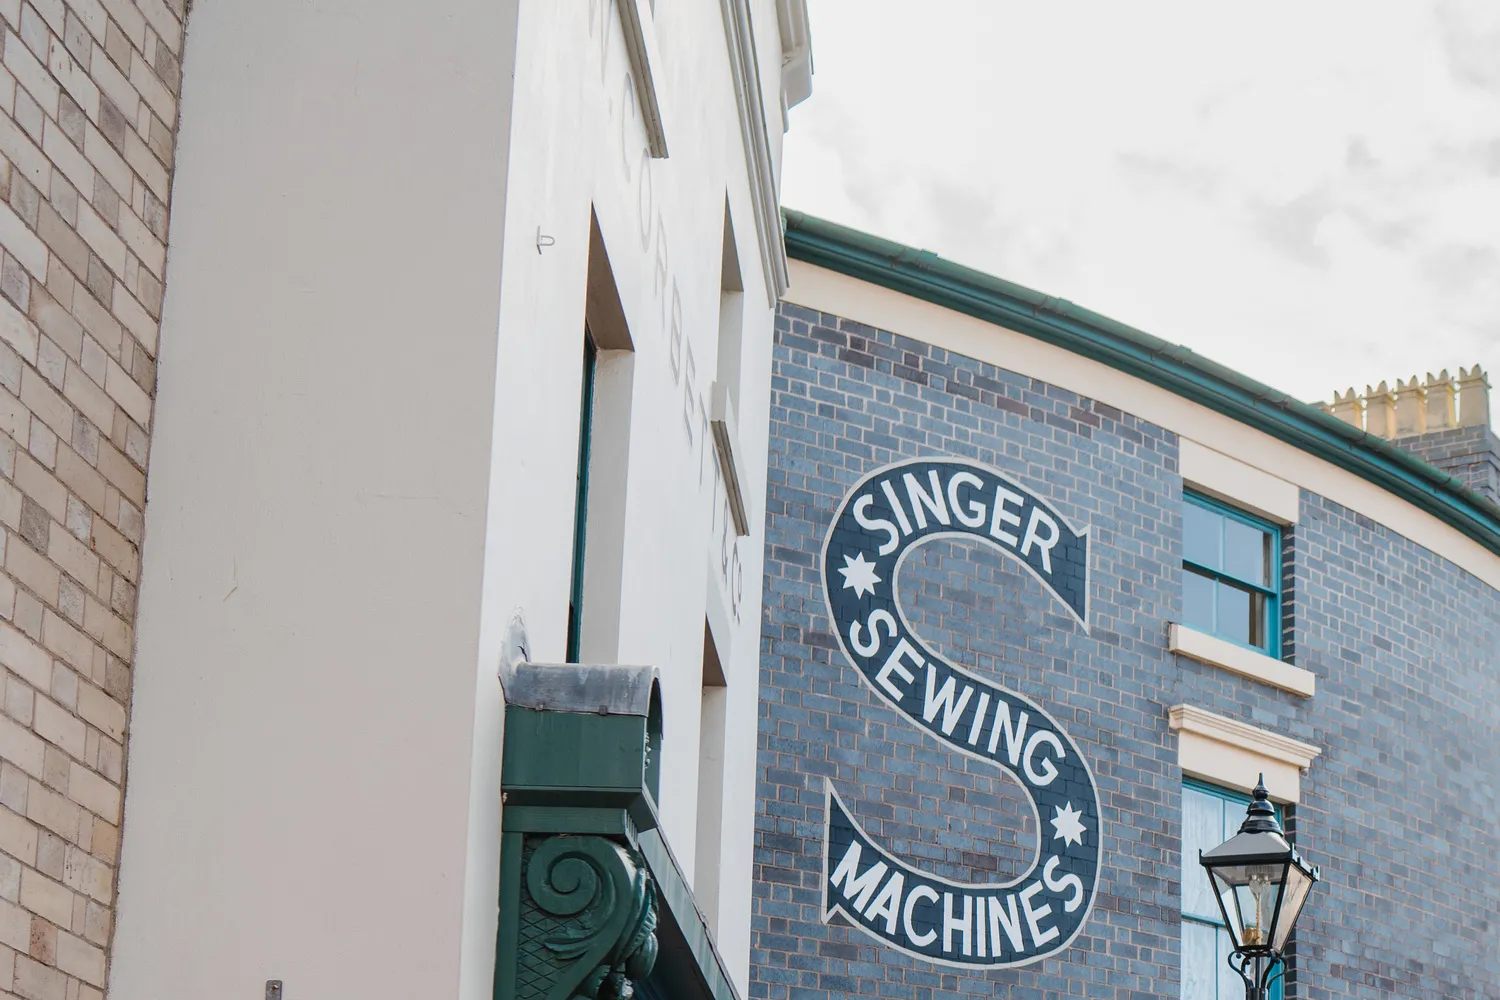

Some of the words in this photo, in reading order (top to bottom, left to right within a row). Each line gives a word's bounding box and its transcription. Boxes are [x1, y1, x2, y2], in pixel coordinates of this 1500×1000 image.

[853, 470, 1060, 574] SINGER
[849, 609, 1066, 786] SEWING
[830, 840, 1084, 957] MACHINES
